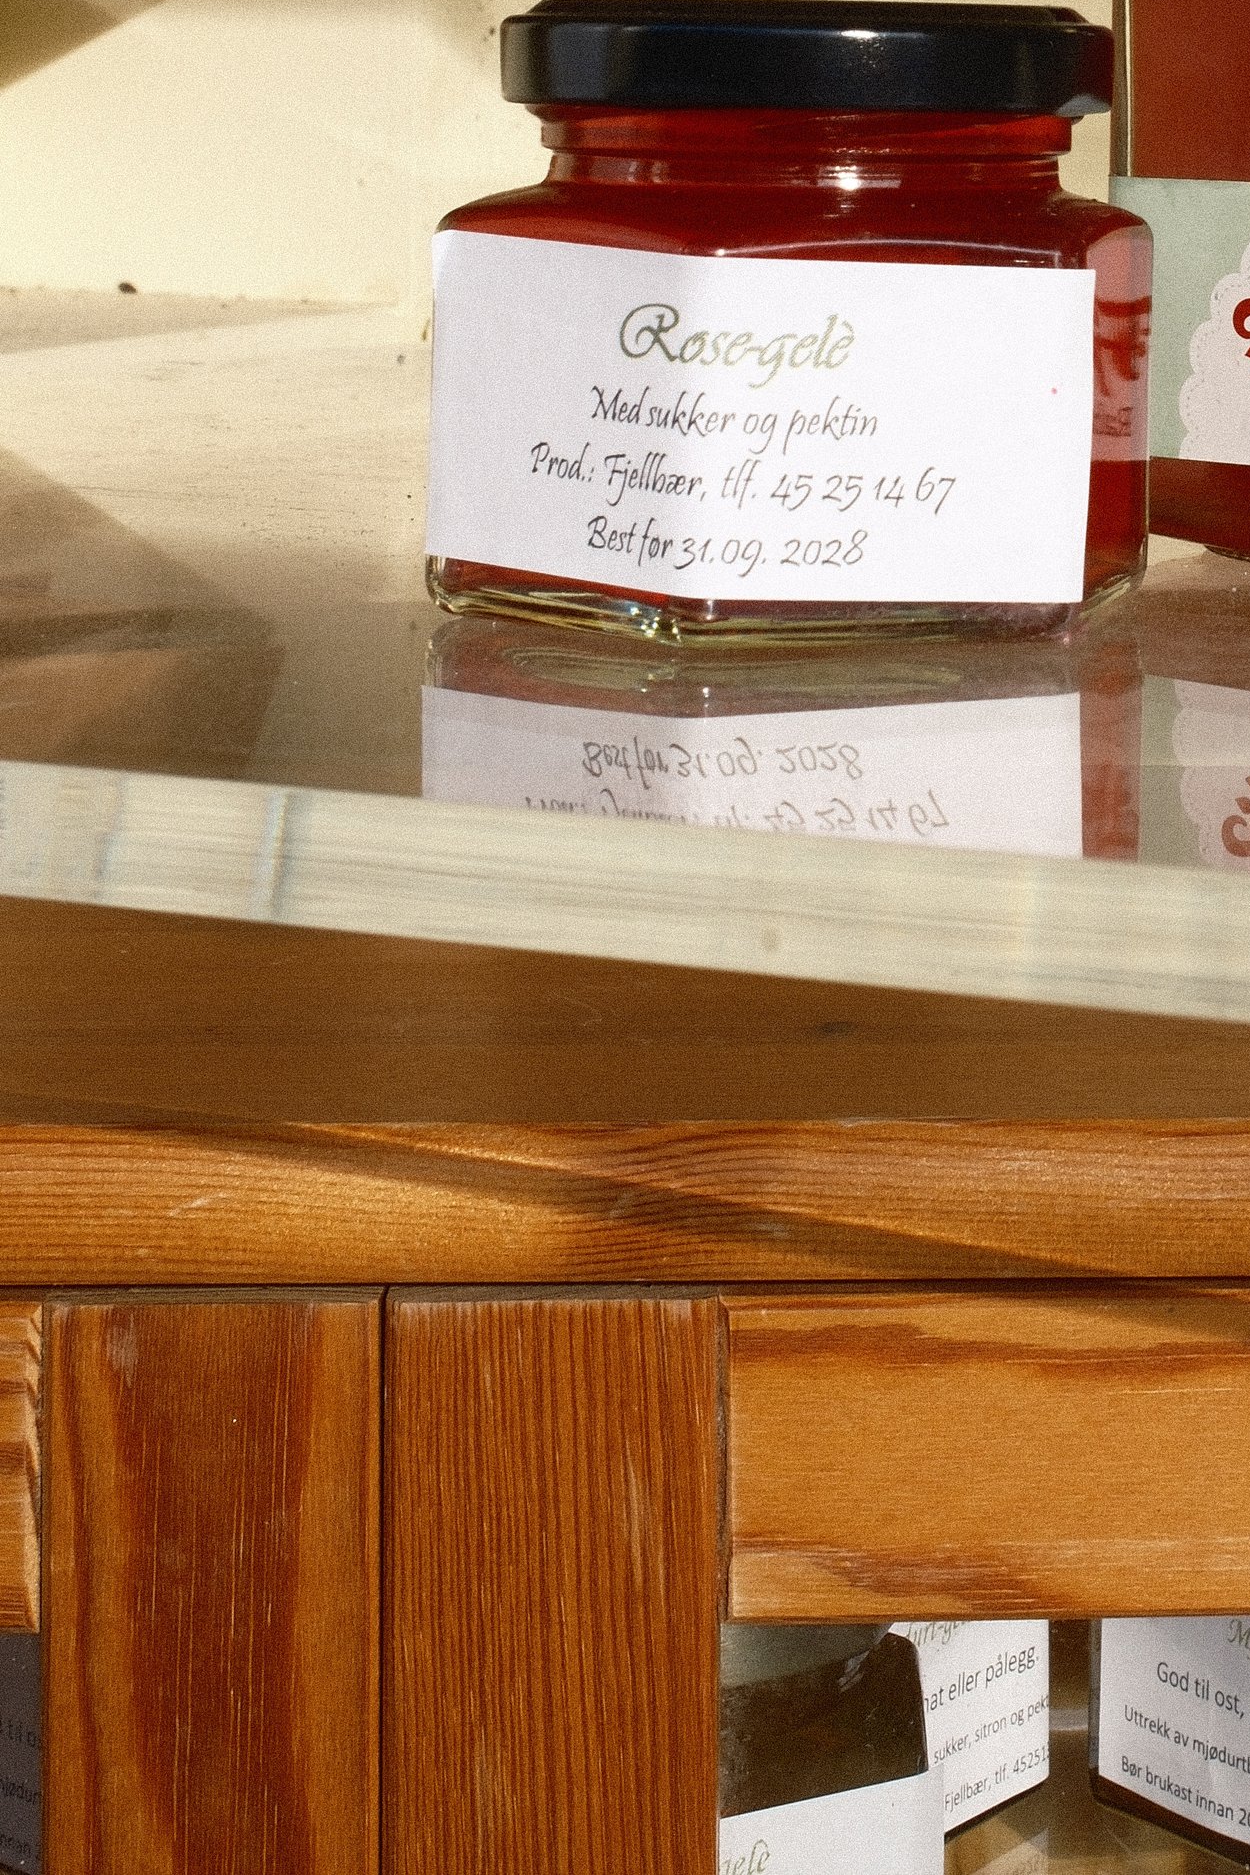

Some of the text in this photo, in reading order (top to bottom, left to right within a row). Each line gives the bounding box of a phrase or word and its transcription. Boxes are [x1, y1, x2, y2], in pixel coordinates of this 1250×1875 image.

[591, 385, 878, 454] Med sukker og pektin
[531, 441, 957, 515] Prod.: Fjellbær, tlf. 45 25 14 67
[588, 515, 636, 554] Best
[780, 529, 869, 567] 2028
[949, 1671, 982, 1702] eller
[985, 1646, 1040, 1689] pålegg.
[1156, 1661, 1190, 1693] God
[1194, 1677, 1210, 1702] til
[1214, 1690, 1244, 1721] ost,
[934, 1734, 972, 1765] sukker,
[974, 1717, 1007, 1743] sitron
[1010, 1709, 1025, 1726] og
[1124, 1704, 1170, 1740] Uttrekk
[1174, 1728, 1189, 1748] av
[944, 1777, 992, 1813] Fjellbær,
[995, 1763, 1010, 1785] tlf.
[1121, 1755, 1142, 1779] Bør
[1146, 1767, 1193, 1804] brukast
[1196, 1794, 1234, 1821] innan
